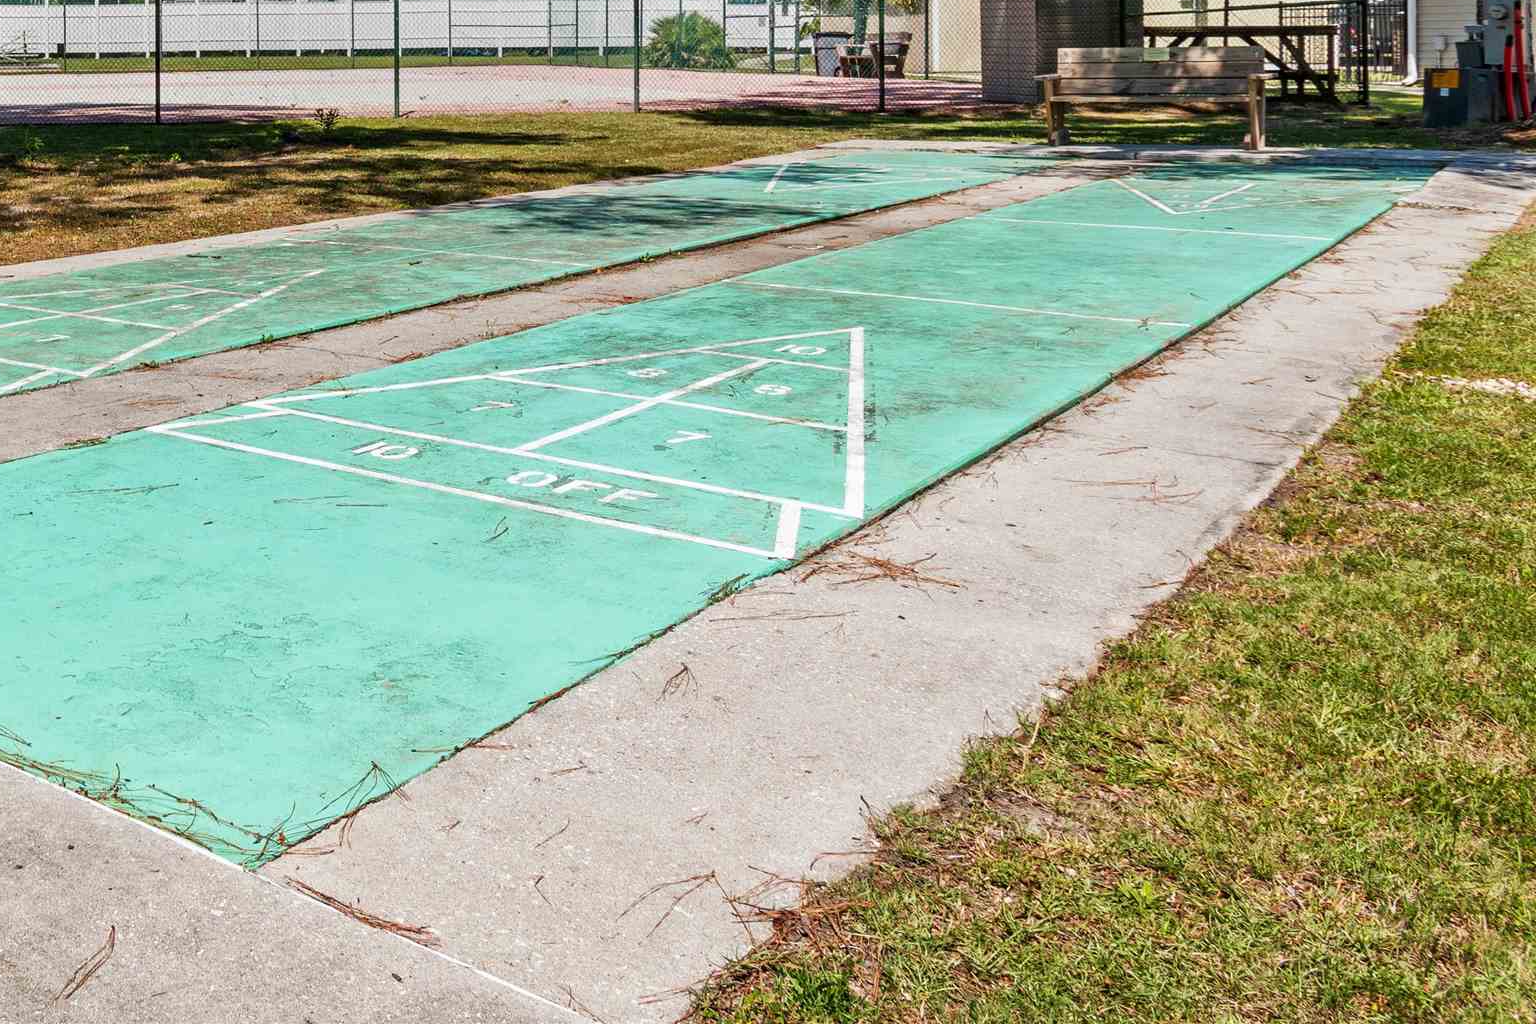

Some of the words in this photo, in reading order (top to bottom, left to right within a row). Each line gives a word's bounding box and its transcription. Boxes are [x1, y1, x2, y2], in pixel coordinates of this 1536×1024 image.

[773, 344, 827, 355] 10
[470, 400, 514, 412] 7
[666, 430, 712, 444] 7
[352, 440, 420, 460] 10
[506, 470, 659, 503] OFF
